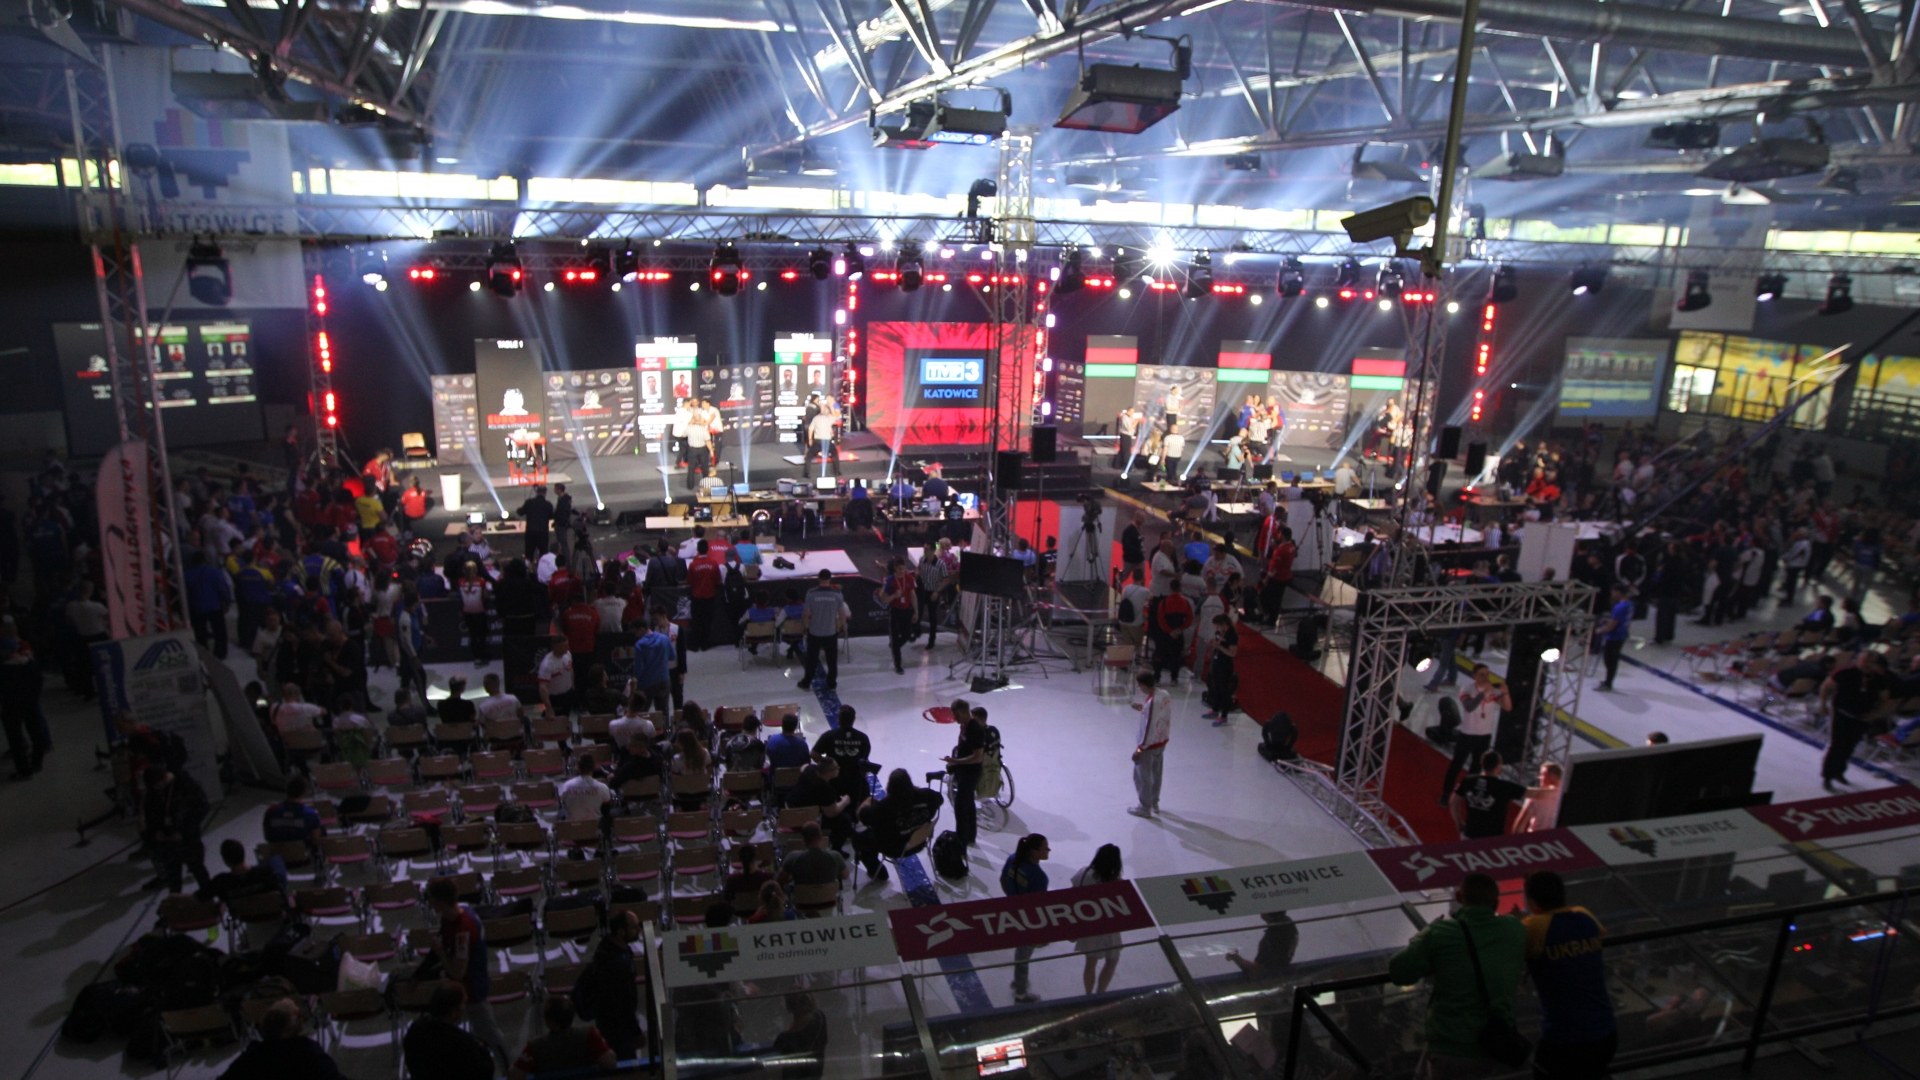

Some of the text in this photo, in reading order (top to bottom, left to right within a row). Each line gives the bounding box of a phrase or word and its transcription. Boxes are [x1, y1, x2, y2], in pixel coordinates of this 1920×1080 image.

[924, 389, 979, 399] KATOWICE
[1815, 796, 1920, 825] TAURON
[1654, 819, 1739, 838] KATOWICE
[1442, 840, 1576, 872] TAURON
[1240, 865, 1345, 890] KATOWICE
[1251, 886, 1309, 900] dla odmiany
[972, 895, 1132, 936] TAURON
[753, 923, 879, 949] KATOWICE
[756, 947, 829, 961] dla odmiany
